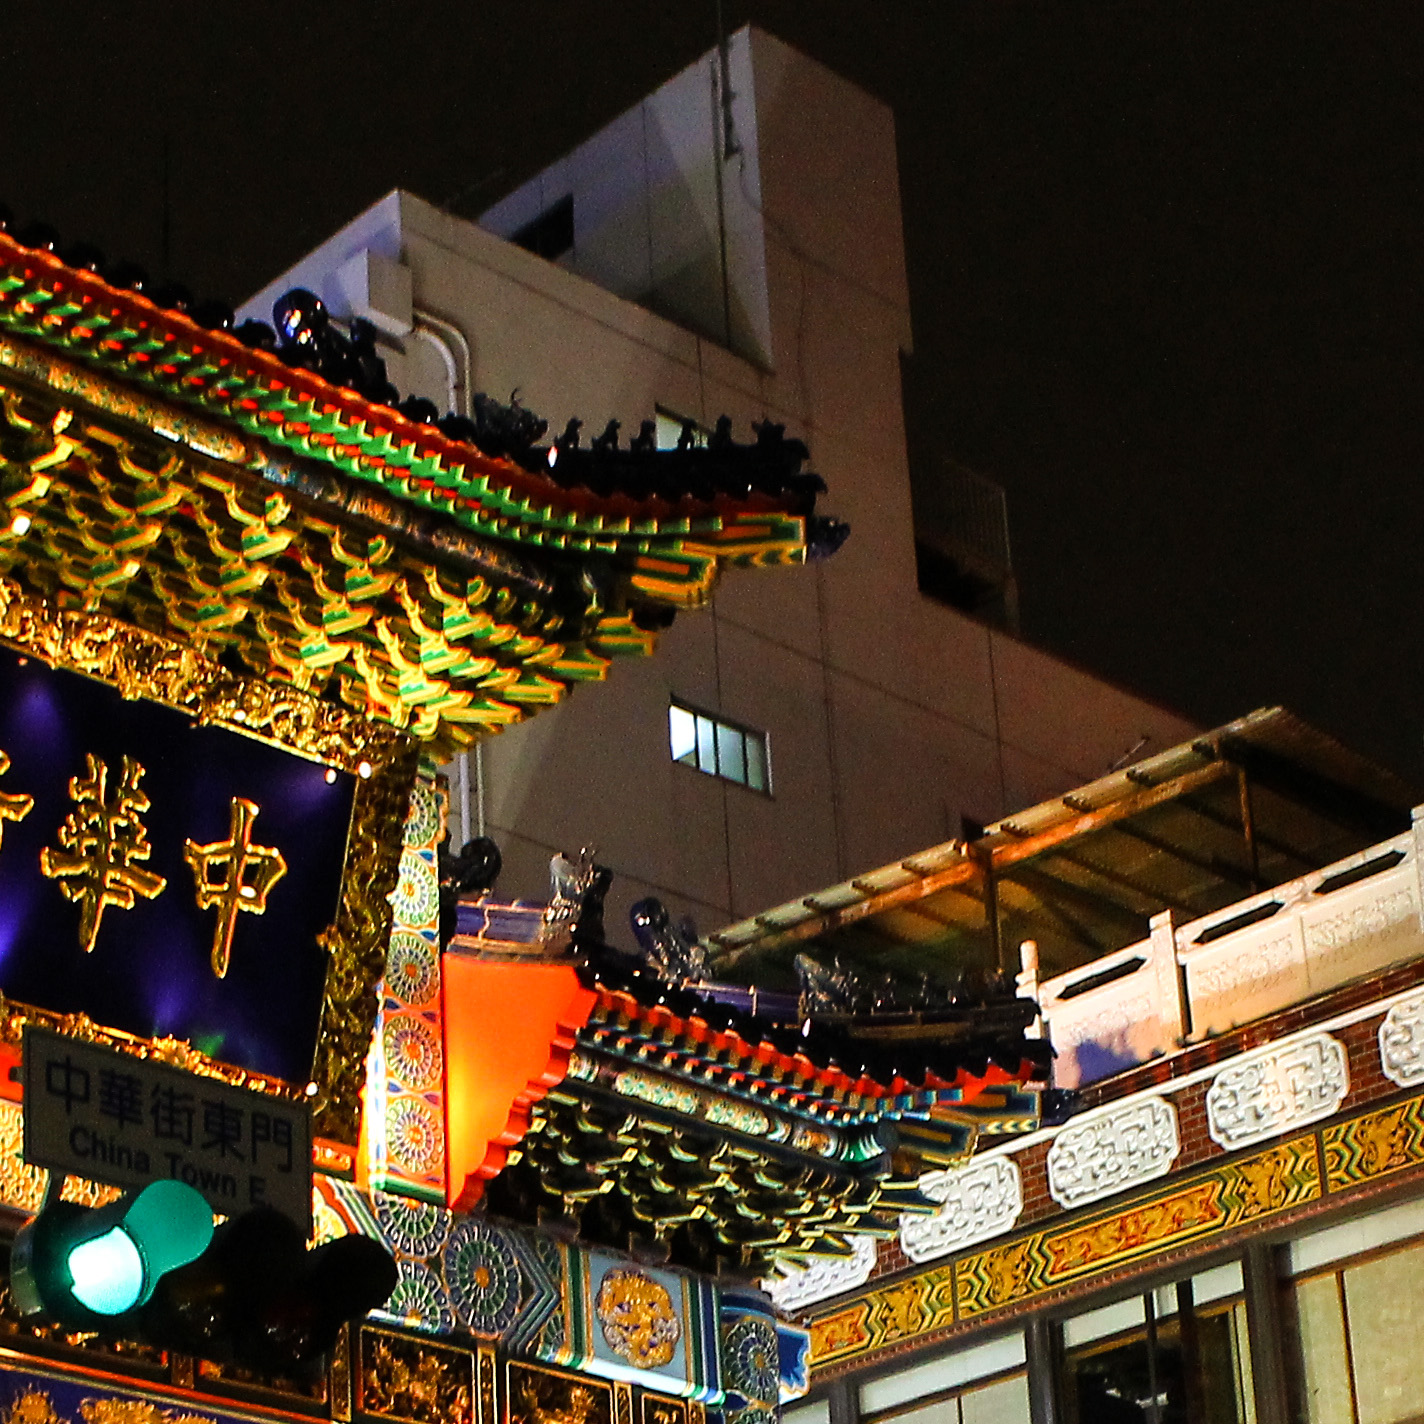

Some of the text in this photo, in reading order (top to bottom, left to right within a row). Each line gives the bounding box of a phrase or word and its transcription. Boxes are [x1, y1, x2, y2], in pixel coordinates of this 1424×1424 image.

[46, 1055, 293, 1173] 中華街東門
[69, 1124, 150, 1174] China
[163, 1151, 237, 1199] Town
